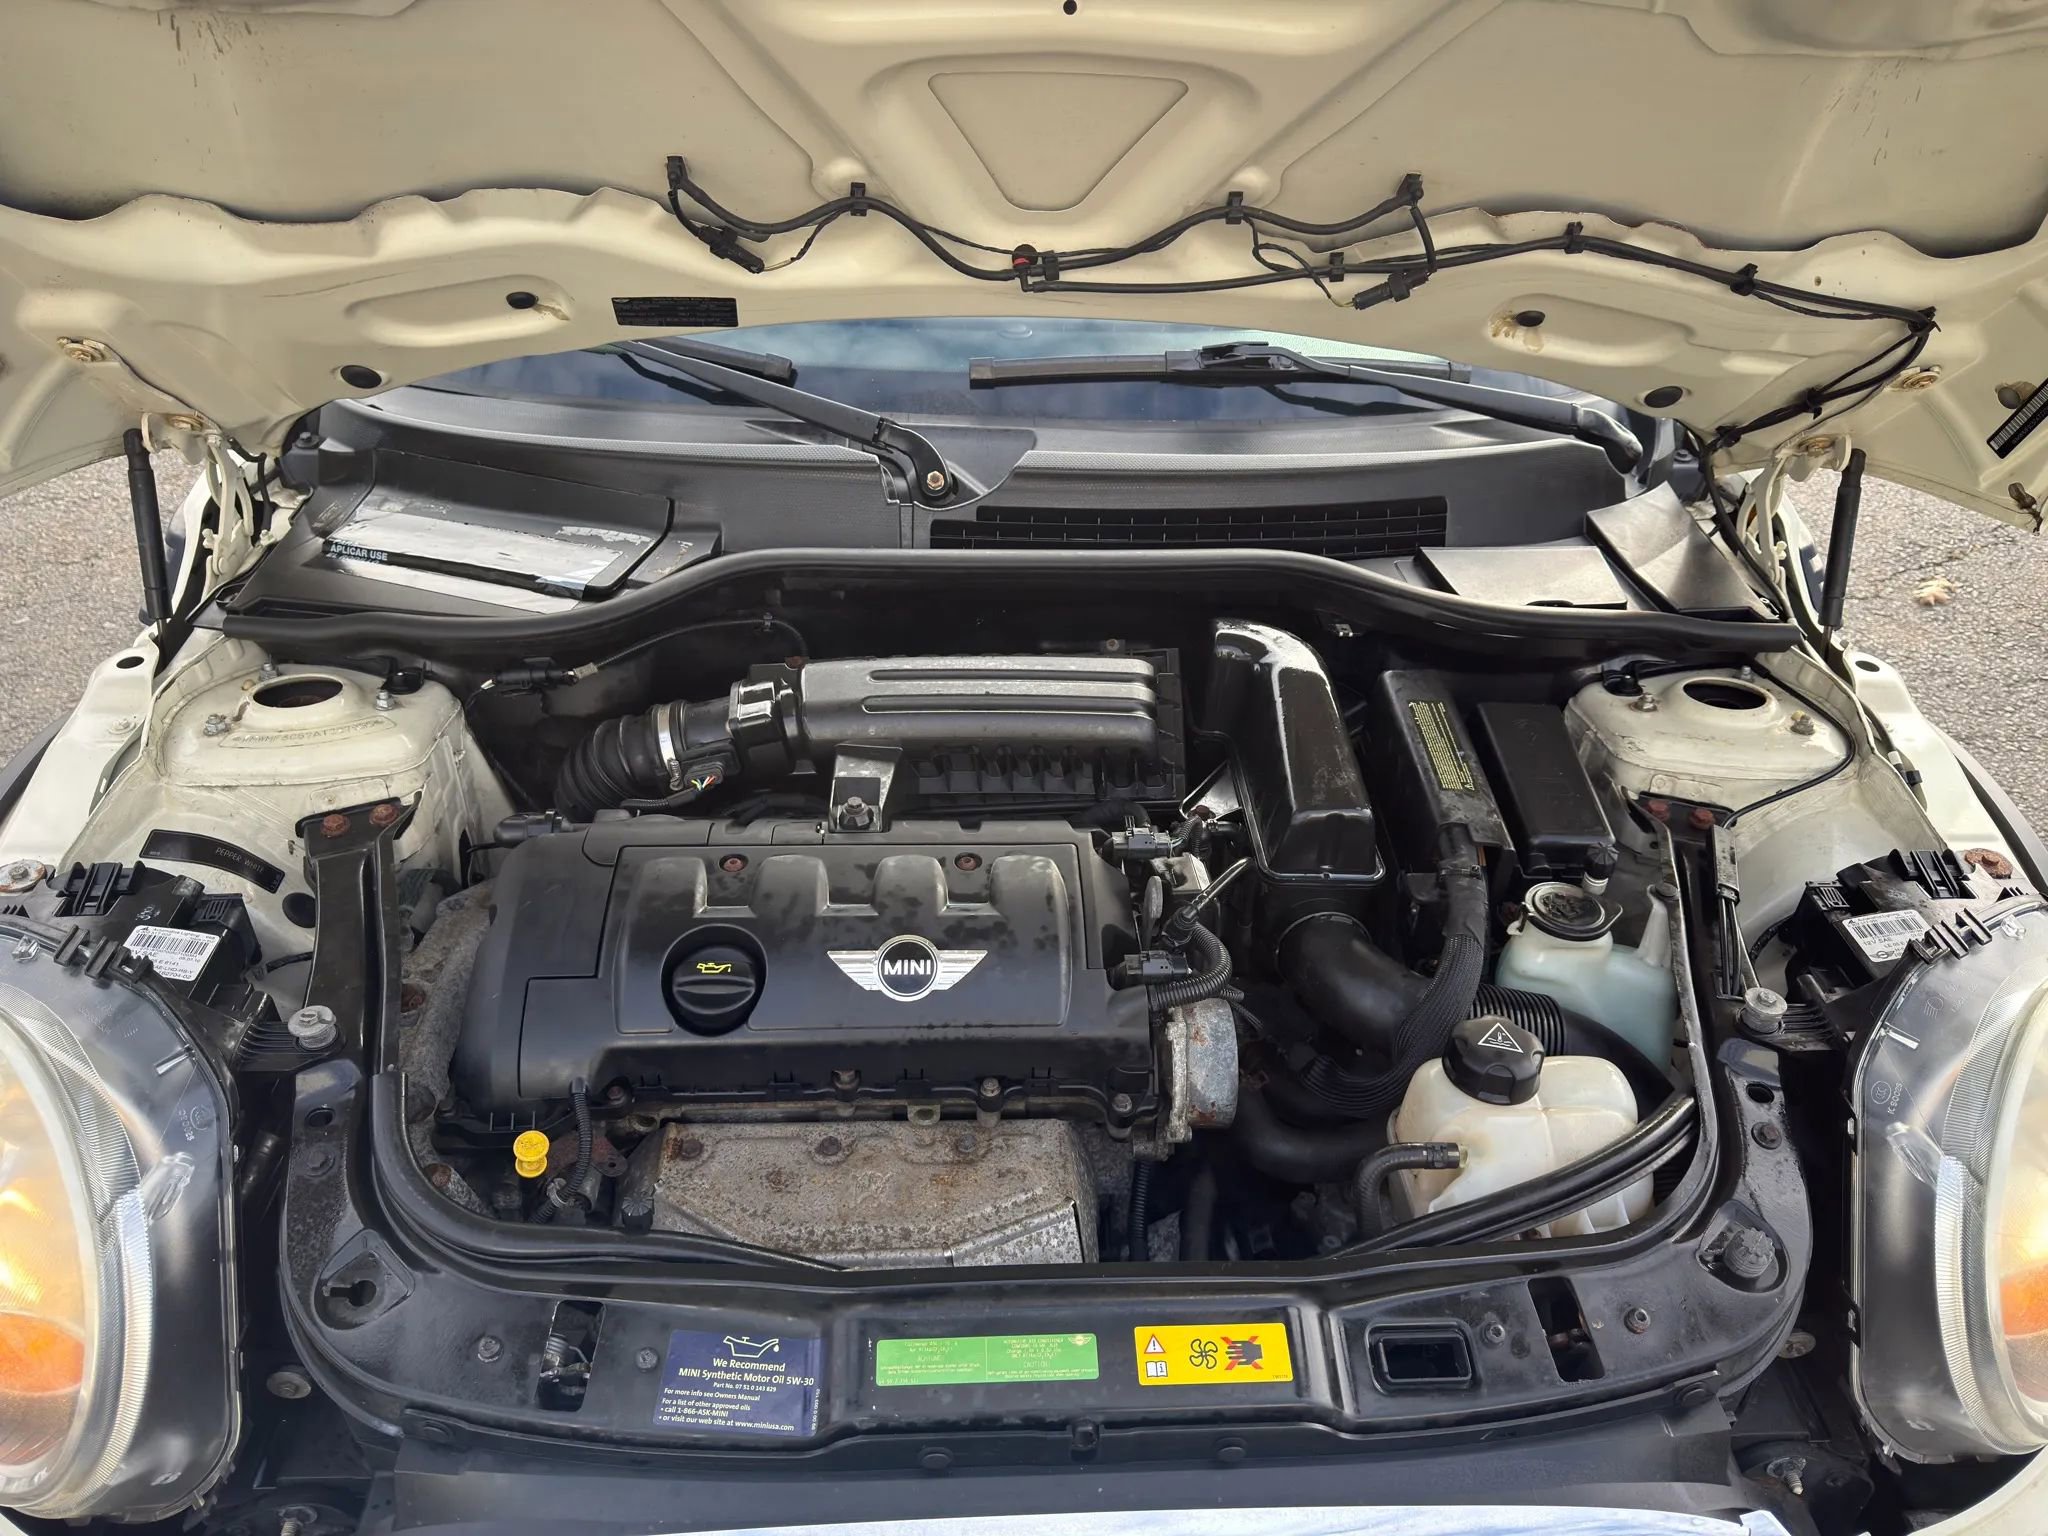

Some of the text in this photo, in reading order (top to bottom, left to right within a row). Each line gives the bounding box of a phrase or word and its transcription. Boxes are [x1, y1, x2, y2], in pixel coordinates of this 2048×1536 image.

[330, 543, 368, 558] APLICAR
[369, 549, 388, 561] USE
[215, 847, 242, 862] PEPPER
[883, 959, 932, 976] MINI
[713, 1357, 786, 1372] We Recommend
[678, 1367, 815, 1386] MINI Synthetic Motor Oil 5W-30
[690, 1389, 703, 1397] info
[714, 1391, 737, 1400] Owners
[737, 1393, 761, 1401] Manual
[662, 1397, 672, 1405] For
[677, 1398, 687, 1406] list
[694, 1400, 711, 1408] other
[711, 1401, 740, 1410] approved
[740, 1403, 751, 1411] oils
[664, 1406, 729, 1418] call 1-866-ASK-MINI
[671, 1414, 685, 1423] visit
[698, 1417, 713, 1425] web
[713, 1418, 726, 1426] site
[726, 1419, 734, 1427] at
[734, 1420, 795, 1432] www.miniusa.com
